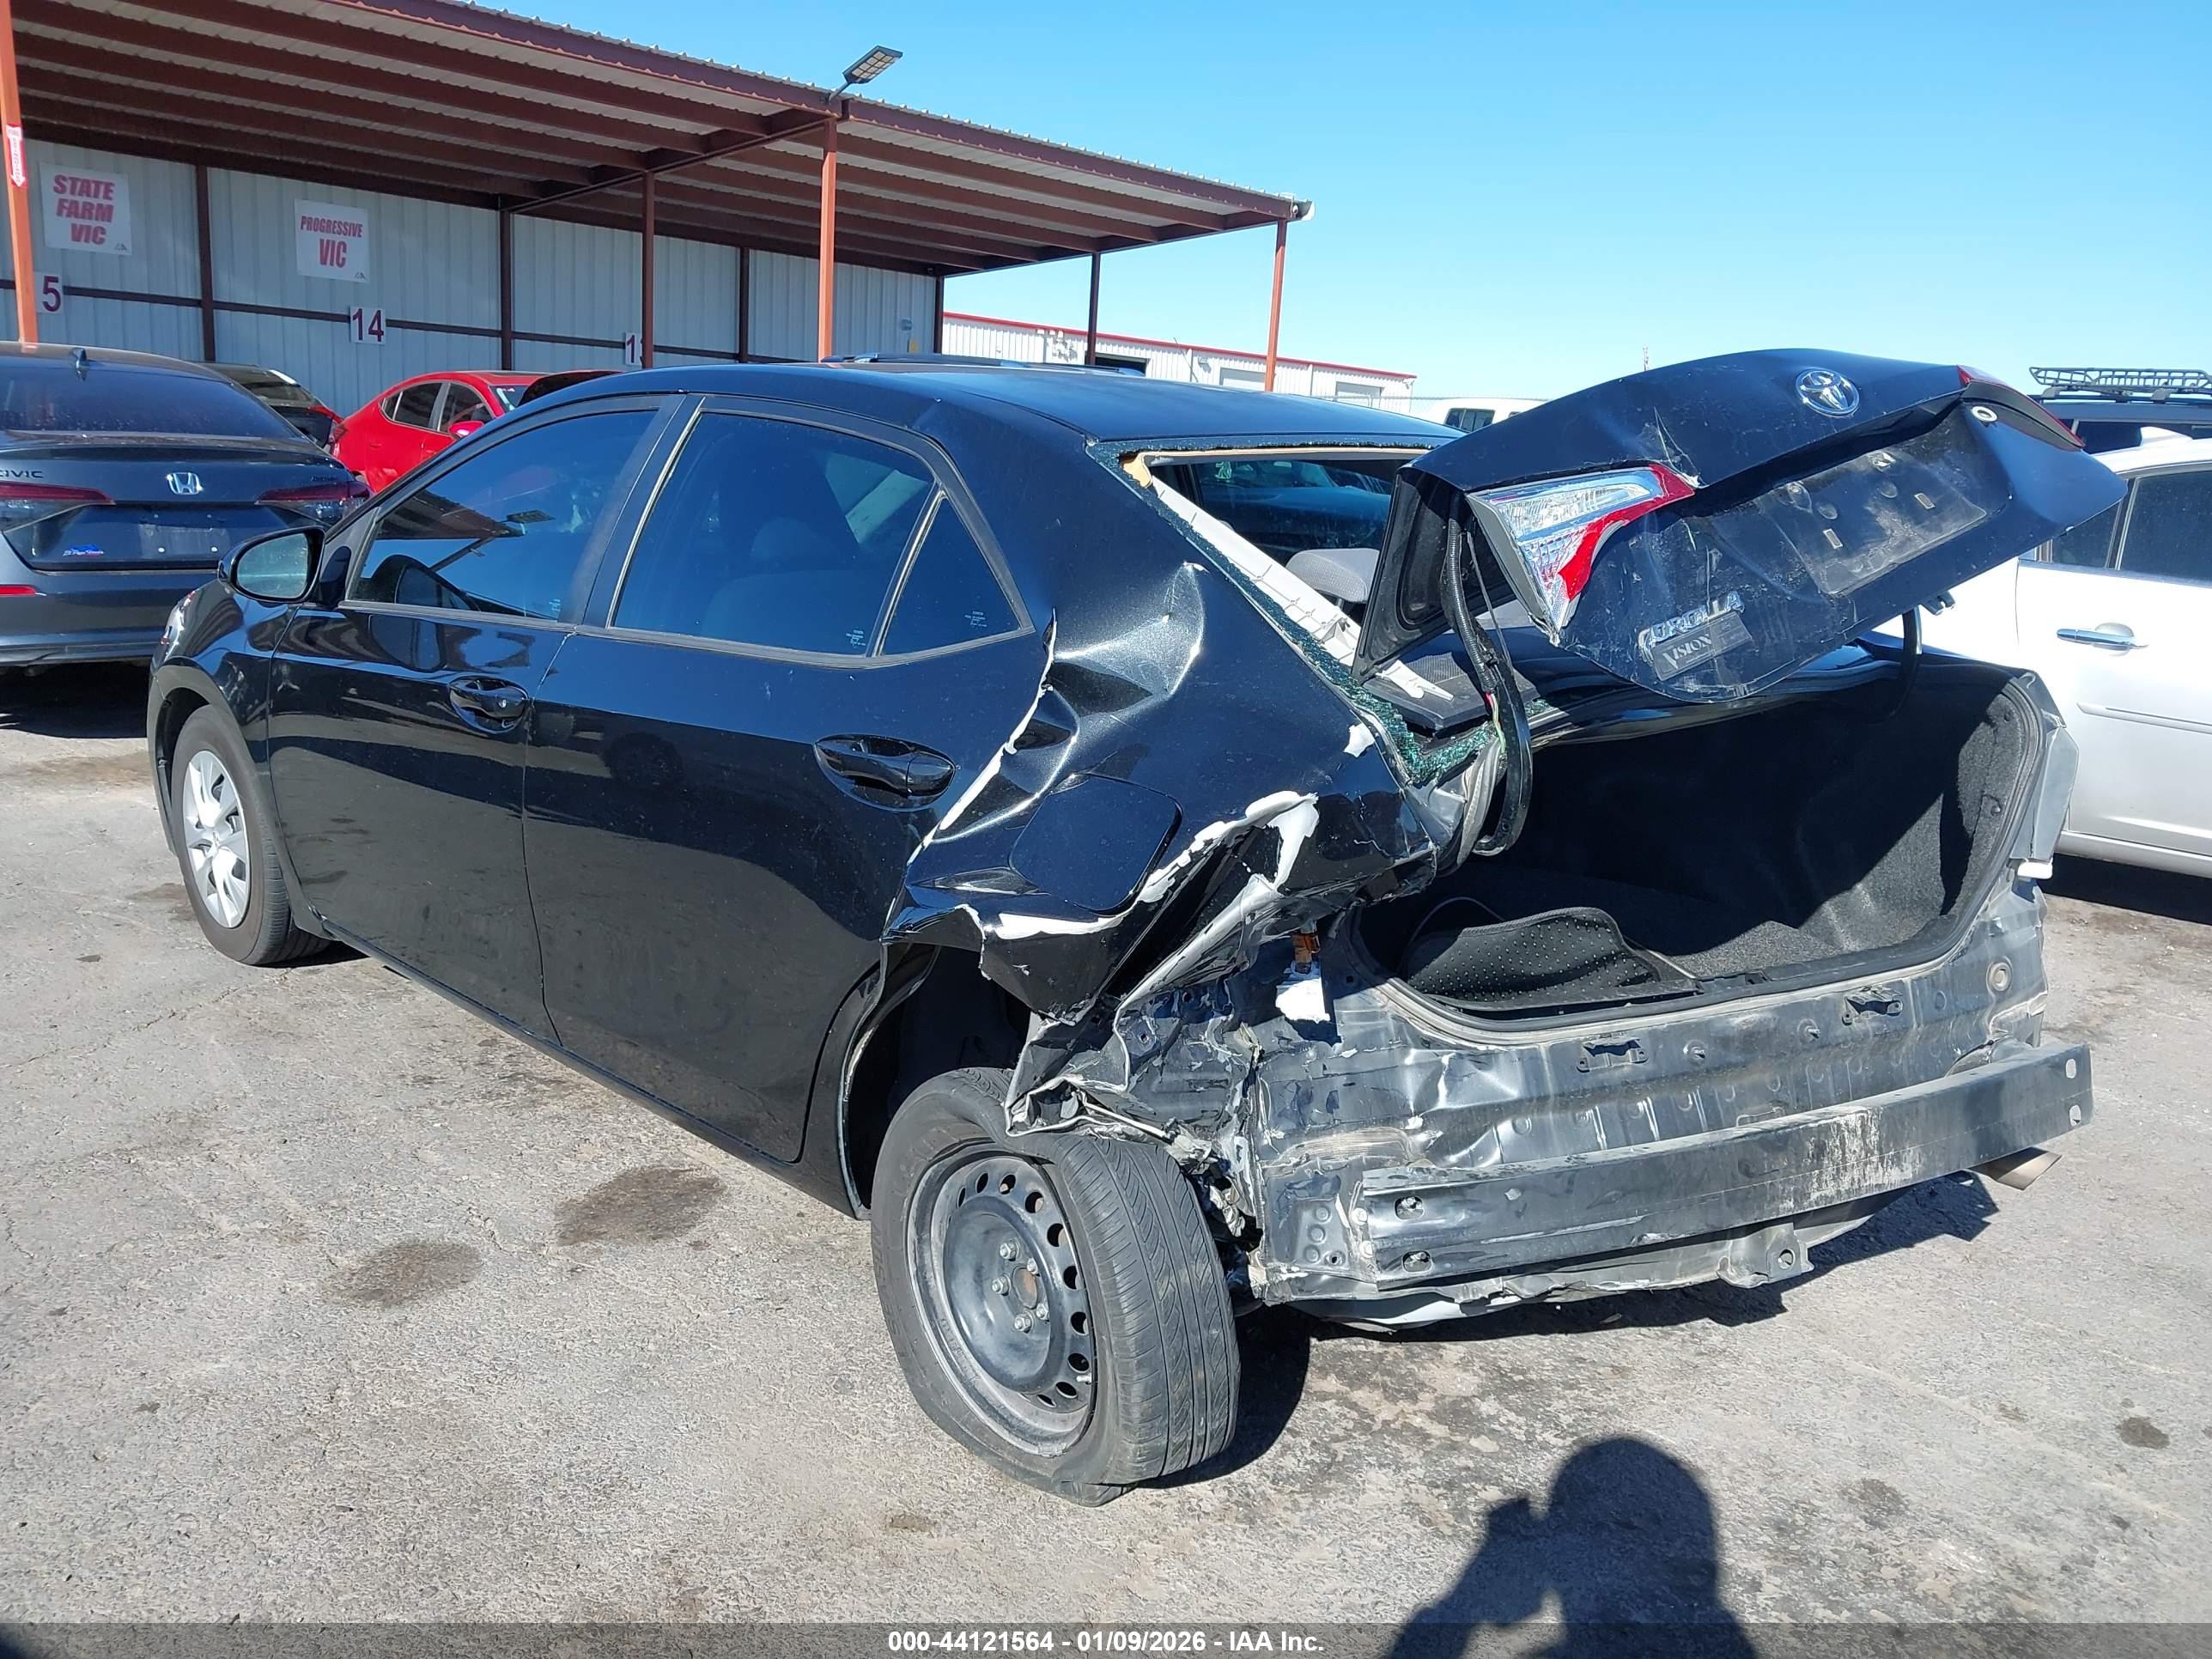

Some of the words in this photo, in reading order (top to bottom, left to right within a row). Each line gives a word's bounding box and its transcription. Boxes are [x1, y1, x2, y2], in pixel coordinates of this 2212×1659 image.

[53, 174, 115, 201] STATE
[56, 198, 114, 223] FARM
[70, 222, 106, 246] VIC
[301, 215, 363, 239] PROGRESSIVE
[319, 238, 347, 269] VIC
[352, 307, 384, 343] 14
